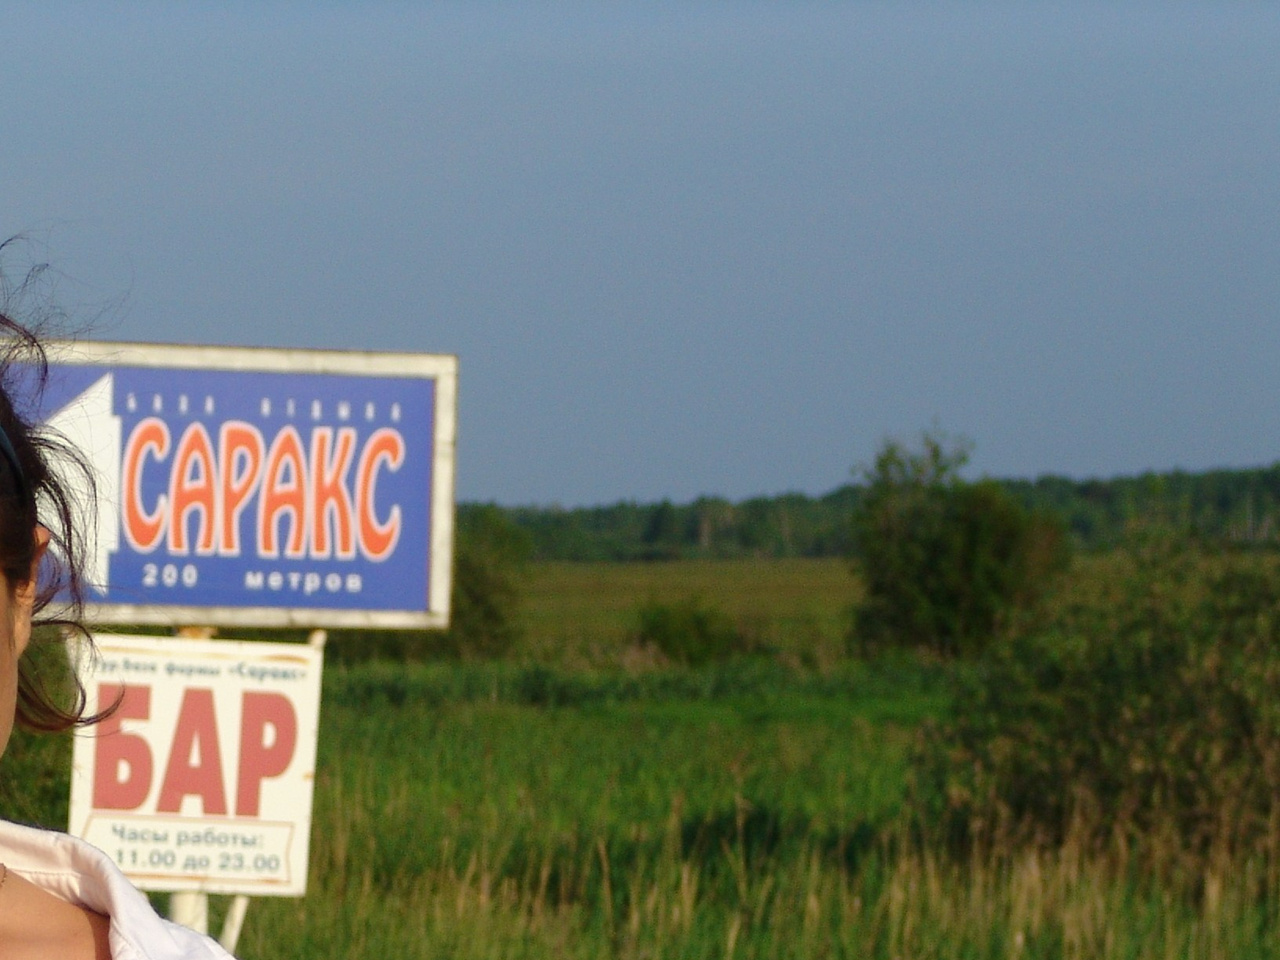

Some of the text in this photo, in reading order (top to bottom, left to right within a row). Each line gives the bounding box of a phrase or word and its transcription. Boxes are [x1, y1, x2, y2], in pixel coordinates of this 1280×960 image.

[122, 416, 405, 563] САРАКС
[141, 562, 362, 596] 200 метров
[92, 683, 297, 817] БАР
[112, 824, 169, 843] Часы
[183, 855, 210, 870] до
[219, 851, 280, 872] 23.00
